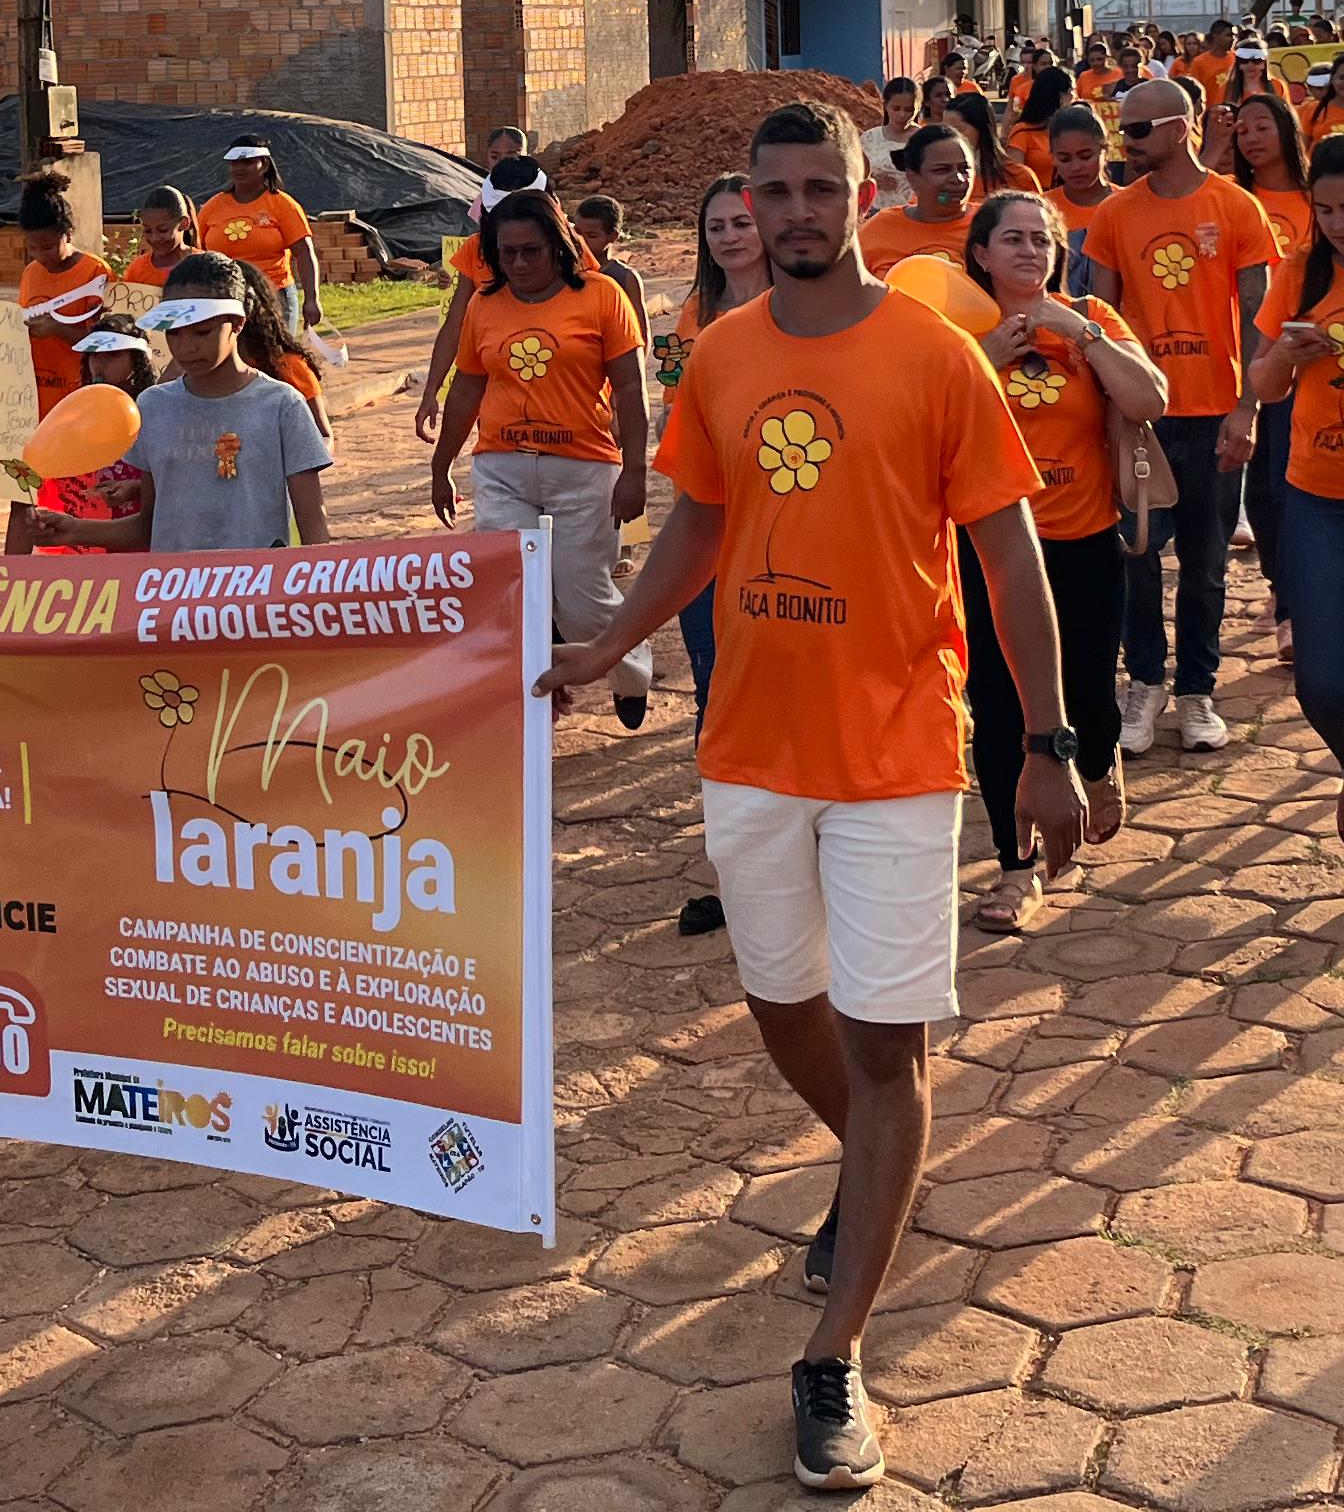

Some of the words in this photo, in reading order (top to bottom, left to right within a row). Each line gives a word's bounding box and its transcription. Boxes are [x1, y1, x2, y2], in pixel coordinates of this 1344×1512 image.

[1313, 431, 1344, 451] FAÇA
[135, 564, 274, 603] CONTRA
[283, 551, 475, 601] CRIANÇAS
[739, 587, 770, 619] FAÇA
[776, 593, 847, 624] BONITO
[138, 608, 161, 642] E
[171, 596, 466, 642] ADOLESCENTES
[207, 663, 451, 804] Maio
[151, 790, 456, 932] laranja
[119, 916, 235, 947] CAMPANHA
[239, 928, 266, 951] DE
[270, 931, 460, 979] CONSCIENTIZAÇÃO
[464, 958, 476, 981] E
[110, 946, 208, 975] COMBATE
[212, 956, 241, 979] AO
[246, 960, 314, 988] ABUSO
[319, 969, 332, 991] E
[336, 966, 352, 994] À
[356, 974, 486, 1017] EXPLORAÇÃO
[105, 976, 182, 1004] SEXUAL
[186, 984, 212, 1007] DE
[216, 988, 319, 1023] CRIANÇAS
[324, 1002, 336, 1024] E
[341, 1005, 493, 1051] ADOLESCENTES
[162, 1017, 277, 1052] Precisamos
[282, 1031, 328, 1059] falar
[331, 1042, 386, 1070] sobre
[391, 1049, 437, 1080] isso!
[304, 1113, 391, 1143] ASSISTÊNCIA
[305, 1133, 392, 1173] SOCIAL
